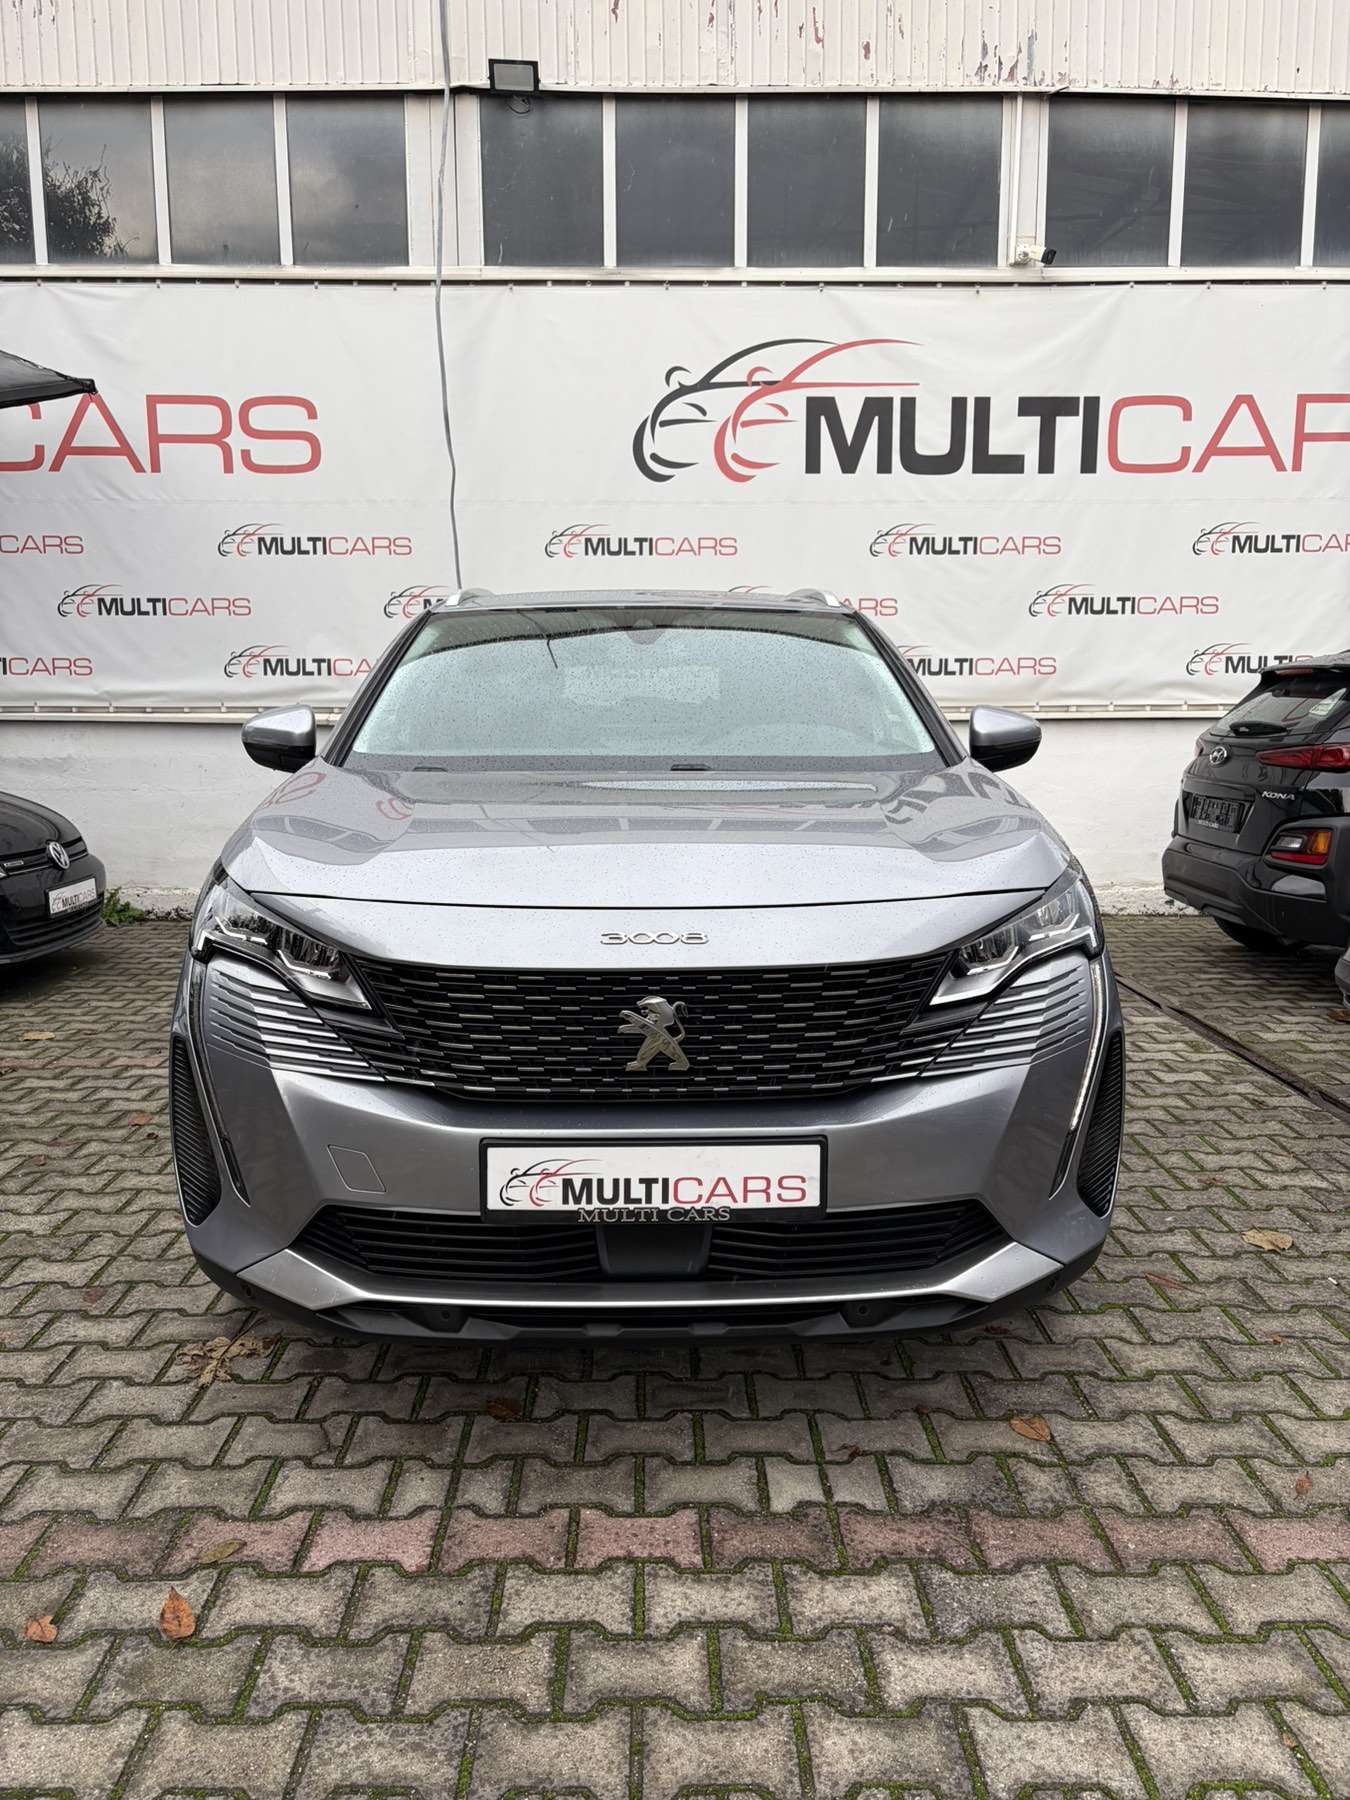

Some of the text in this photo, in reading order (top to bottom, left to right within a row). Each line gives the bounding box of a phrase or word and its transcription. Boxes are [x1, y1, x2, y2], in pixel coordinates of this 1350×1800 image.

[257, 535, 412, 556] MULTICARS
[583, 535, 738, 556] MULTICARS
[908, 535, 1062, 556] MULTICARS
[1231, 533, 1350, 554] MULTICA
[97, 596, 252, 617] MULTICARS
[1067, 595, 1219, 616] MULTICARS
[0, 656, 93, 676] ICARS
[1261, 790, 1296, 800] KONA
[600, 931, 709, 945] 3008
[562, 1175, 807, 1206] MULTICARS
[577, 1207, 731, 1223] MULTI CARS
